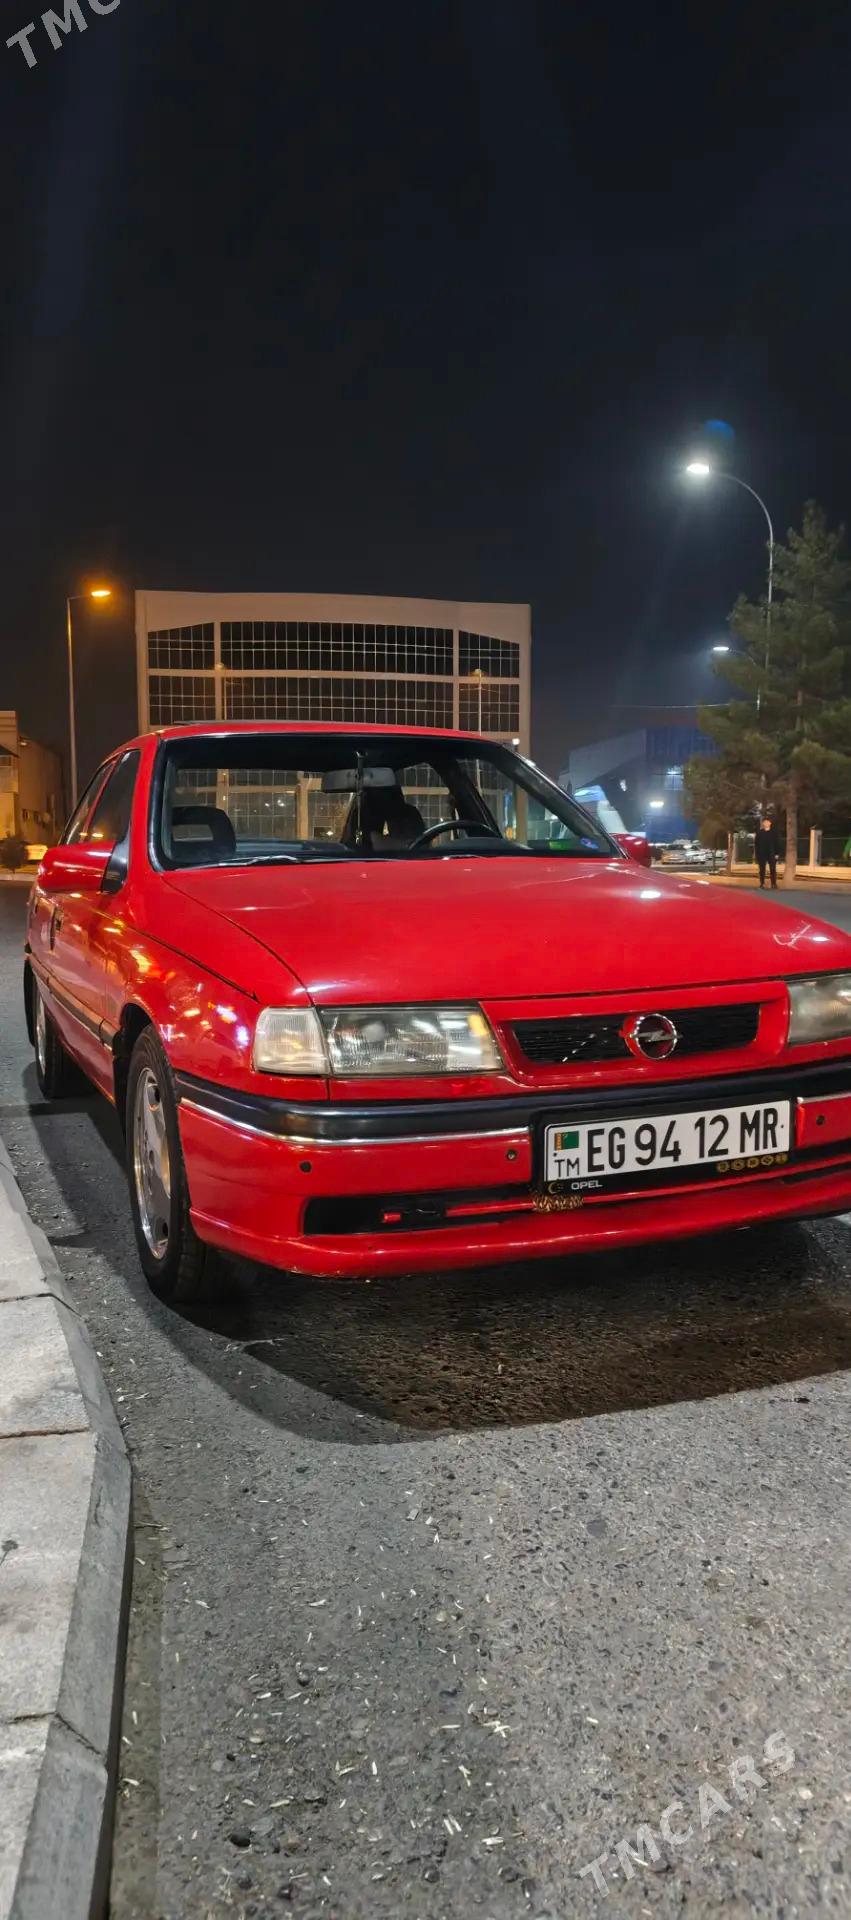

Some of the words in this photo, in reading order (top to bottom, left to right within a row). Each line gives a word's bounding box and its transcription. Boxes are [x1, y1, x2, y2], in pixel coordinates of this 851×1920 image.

[587, 1127, 626, 1173] EG
[634, 1120, 682, 1166] 94
[694, 1114, 729, 1159] 12
[740, 1107, 778, 1153] MR
[554, 1157, 580, 1178] TM
[571, 1180, 603, 1190] OPEL
